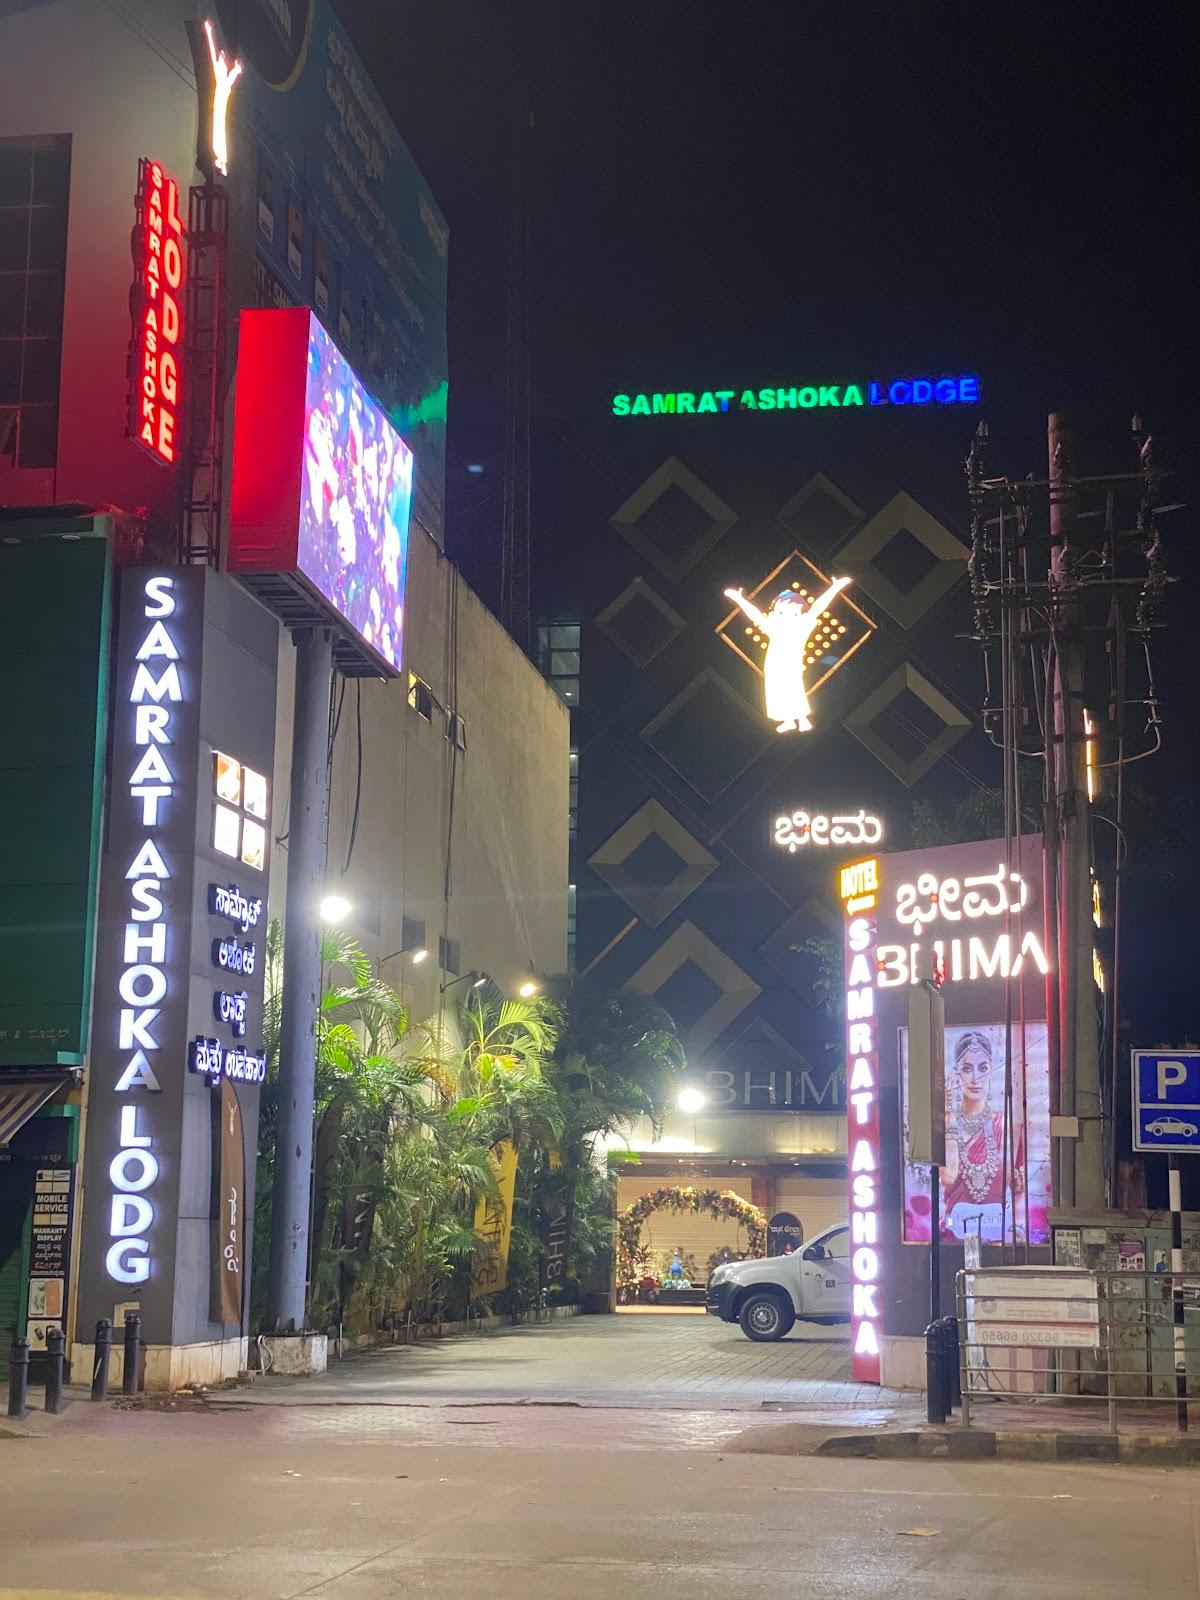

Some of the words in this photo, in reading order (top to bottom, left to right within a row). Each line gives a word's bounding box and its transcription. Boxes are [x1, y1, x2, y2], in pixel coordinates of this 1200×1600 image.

[147, 163, 163, 300] SAMRAT
[157, 179, 182, 462] LODGE
[141, 307, 158, 446] ASHOKA
[612, 390, 734, 416] SAMRAT
[739, 385, 864, 411] ASHOKA
[129, 576, 183, 827] SAMRAT
[775, 809, 881, 853] ಭೀಮ
[841, 860, 878, 898] HOTEL
[895, 863, 1027, 936] ಭೀಮ
[114, 838, 172, 1092] ASHOKA
[847, 918, 875, 1125] SAMRAT
[1157, 1061, 1187, 1100] P
[34, 1204, 69, 1212] SERVICE
[36, 1194, 68, 1203] MOBILE
[851, 1139, 879, 1356] ASHOKA
